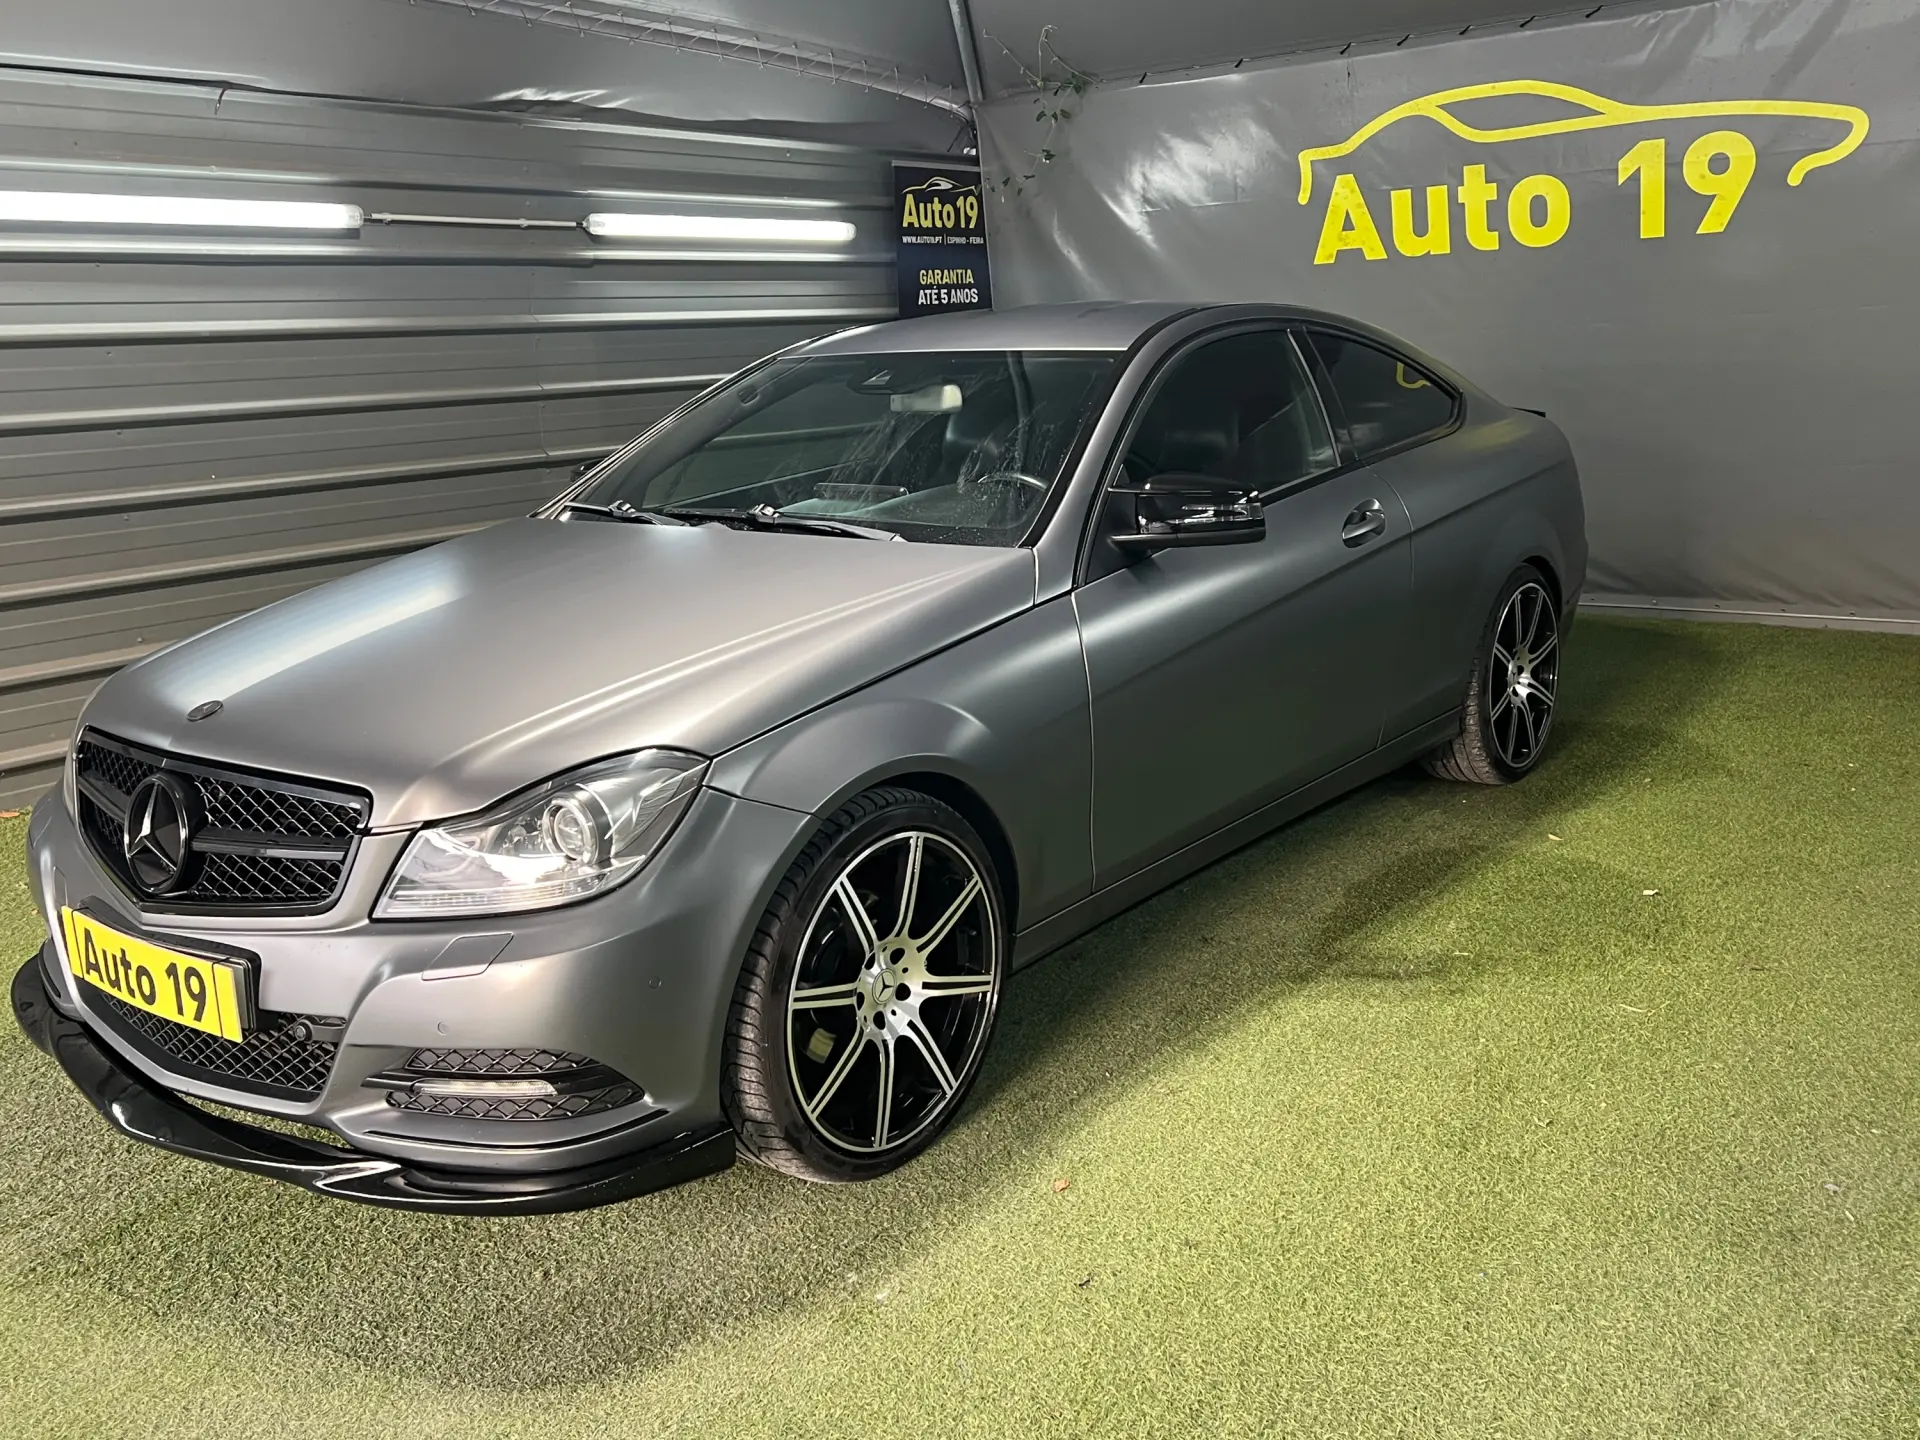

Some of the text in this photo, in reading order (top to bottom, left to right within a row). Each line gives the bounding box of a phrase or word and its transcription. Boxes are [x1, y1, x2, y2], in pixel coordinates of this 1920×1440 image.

[1313, 130, 1756, 265] Auto 19
[902, 194, 978, 228] Auto 19
[970, 236, 984, 244] FEIRA
[919, 269, 974, 284] GARANTIA
[918, 286, 978, 305] ATÉ 5 ANOS
[83, 927, 207, 1023] Auto 19
